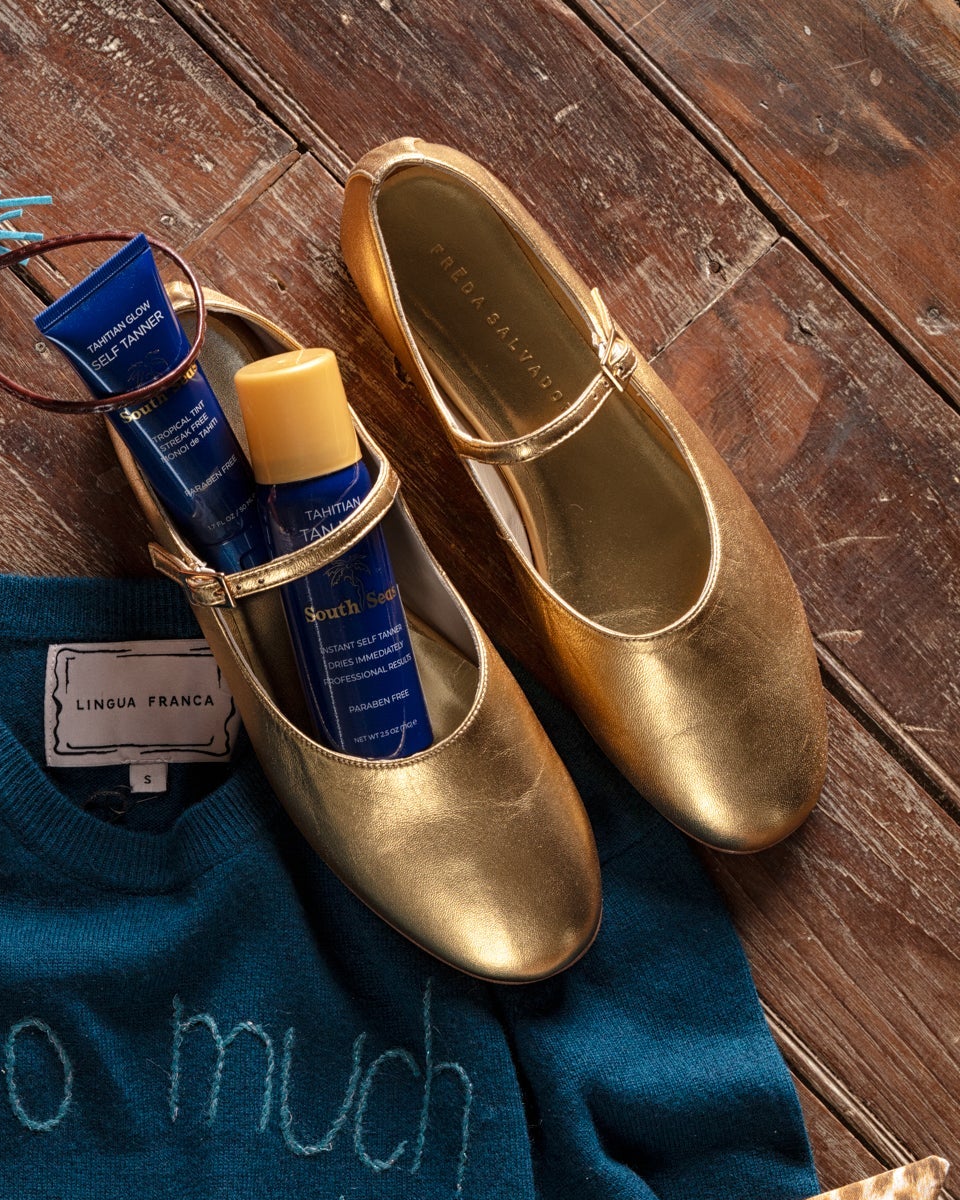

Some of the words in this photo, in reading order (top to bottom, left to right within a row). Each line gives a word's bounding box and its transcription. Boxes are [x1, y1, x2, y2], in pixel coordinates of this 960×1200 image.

[431, 244, 485, 311] FREDA
[87, 320, 127, 354] TAHITIAN
[125, 300, 151, 325] GLOW
[91, 346, 120, 372] SELF
[120, 310, 165, 349] TANNER
[152, 416, 191, 443] TROPICAL
[190, 400, 206, 417] TINT
[159, 430, 192, 452] STREAK
[191, 413, 209, 432] FREE
[160, 445, 190, 464] MONOI
[189, 437, 200, 448] de
[198, 418, 218, 442] TAHITI
[184, 470, 223, 497] PARABEN
[221, 455, 238, 474] FREE
[226, 513, 236, 522] OZ
[305, 496, 361, 521] TAHITIAN
[304, 599, 361, 623] South
[366, 585, 398, 608] Seas
[356, 634, 377, 648] SELF
[378, 623, 403, 640] TANNER
[323, 666, 388, 686] PROFESSIONAL
[388, 653, 412, 671] RESULTS
[328, 658, 354, 670] DRIES
[355, 641, 404, 664] IMMEDIATELY
[76, 697, 136, 710] LINGUA
[148, 695, 215, 707] FRANCA
[349, 697, 390, 713] PARABEN
[391, 688, 410, 702] FREE
[354, 735, 367, 743] NET
[368, 732, 379, 740] WT
[390, 726, 399, 735] OZ
[144, 775, 152, 784] S
[171, 977, 473, 1198] much
